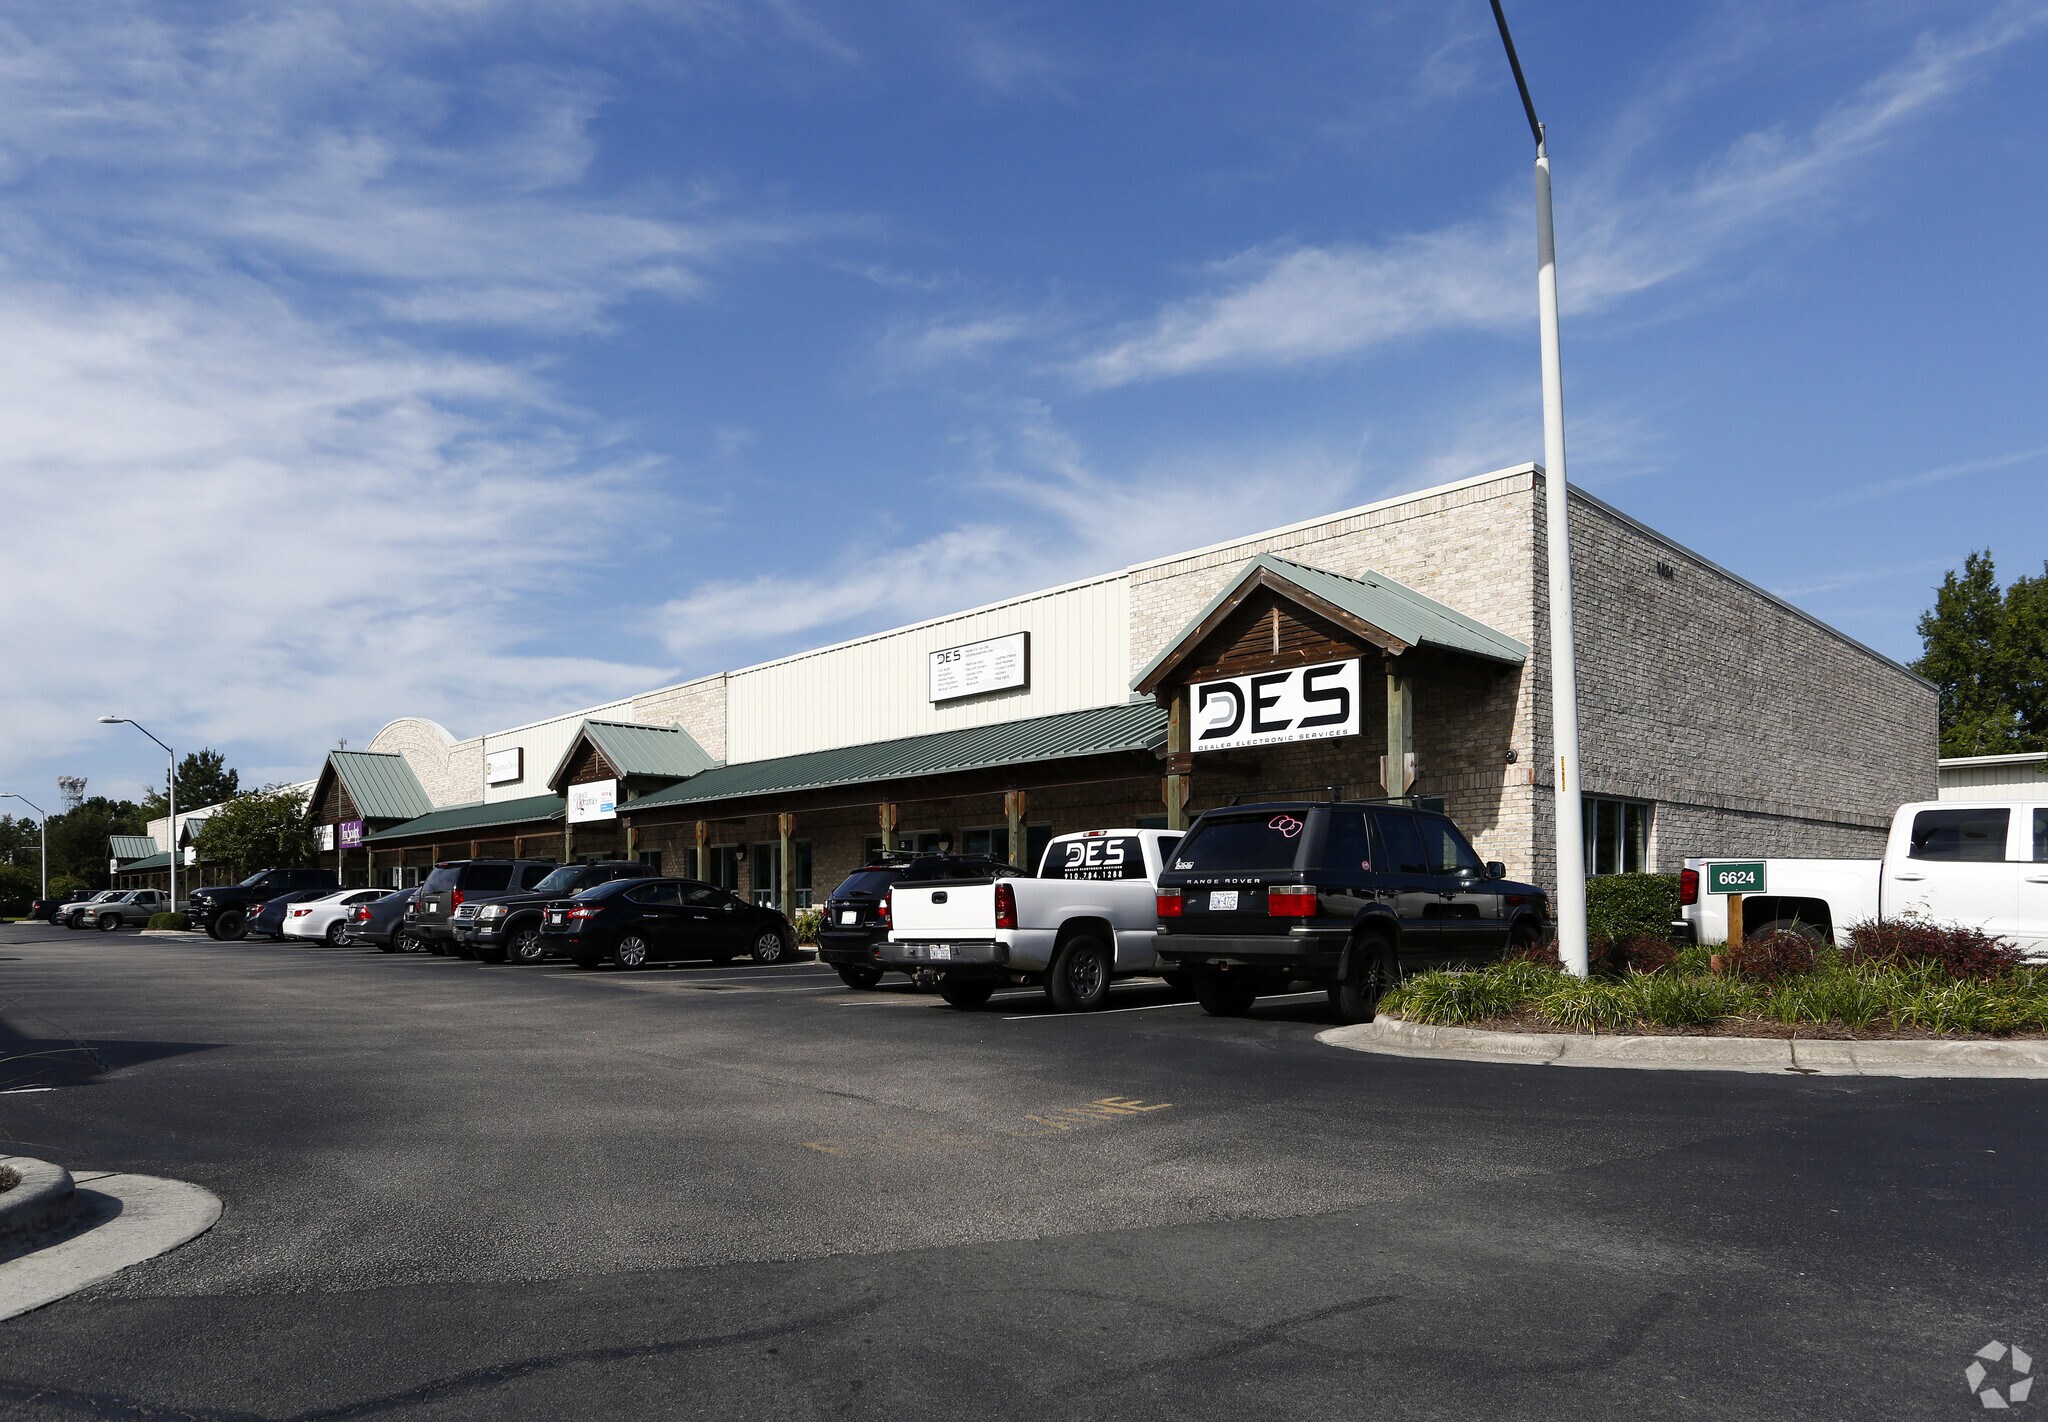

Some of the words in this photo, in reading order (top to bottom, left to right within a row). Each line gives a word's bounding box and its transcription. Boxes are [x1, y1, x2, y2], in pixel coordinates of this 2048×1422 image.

[937, 650, 961, 665] DES
[1198, 662, 1350, 741] DES
[1198, 742, 1232, 751] DEALER
[1236, 735, 1294, 747] ELECTRONIC
[1299, 729, 1348, 740] SERVICES
[1065, 839, 1125, 867] DES
[1719, 871, 1755, 885] 6624
